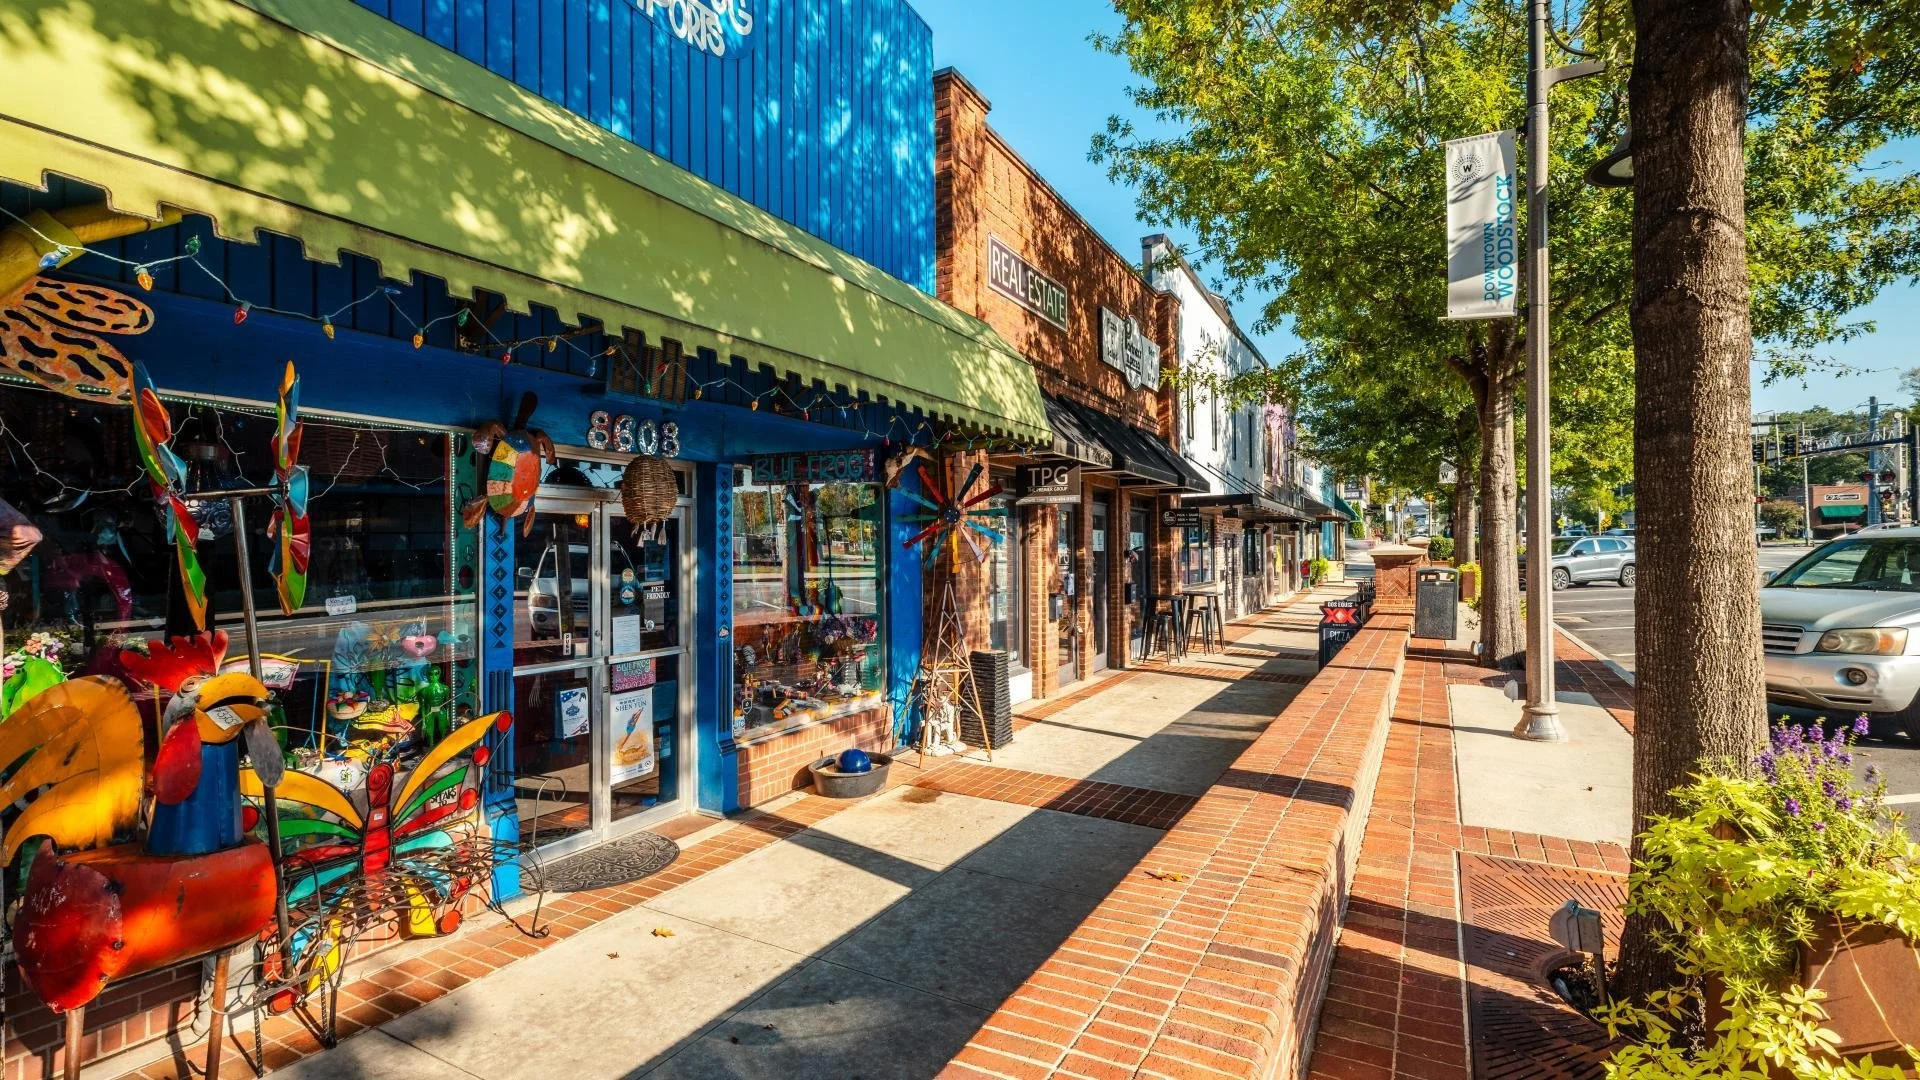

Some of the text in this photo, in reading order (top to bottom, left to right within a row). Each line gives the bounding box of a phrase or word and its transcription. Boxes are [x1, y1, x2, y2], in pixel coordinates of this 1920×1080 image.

[1462, 163, 1472, 173] W
[1496, 173, 1514, 300] WOODSTOCK
[1483, 222, 1495, 302] DOWNTOWN
[992, 245, 1065, 323] REAL ESTATE
[587, 410, 680, 458] 8608
[754, 453, 864, 481] BLUE FROG
[1028, 466, 1068, 486] TPG
[646, 591, 671, 600] FRIENDLY
[1323, 608, 1357, 623] XX
[1330, 630, 1350, 640] PIZZA
[615, 703, 632, 712] SHEN
[634, 700, 647, 708] YUN
[430, 788, 456, 803] SPEAKS
